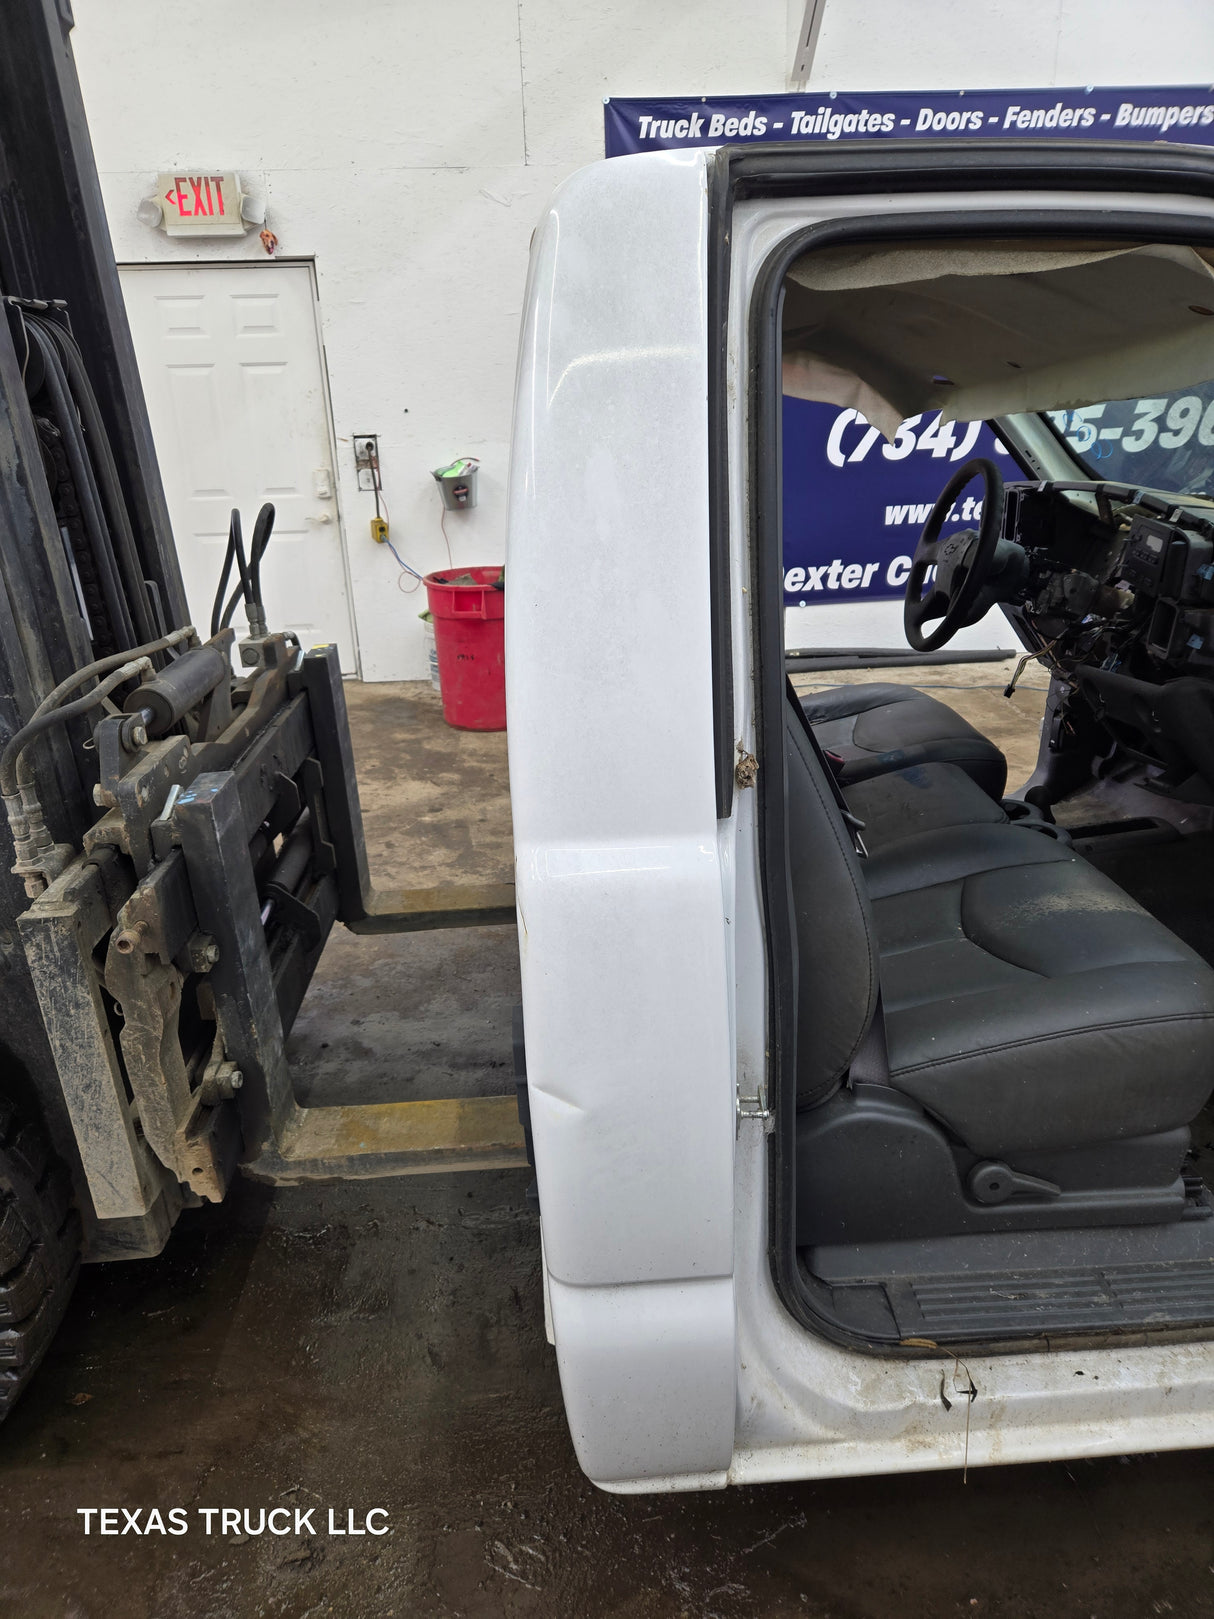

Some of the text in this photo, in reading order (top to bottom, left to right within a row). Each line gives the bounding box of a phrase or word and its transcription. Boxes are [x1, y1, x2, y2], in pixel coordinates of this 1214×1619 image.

[639, 113, 704, 138] Truck
[708, 111, 767, 137] Beds
[791, 107, 895, 140] Tailgates
[916, 108, 984, 131] Doors
[1003, 103, 1096, 129] Fenders
[1113, 103, 1214, 133] Bumpers
[174, 176, 224, 217] EXIT
[783, 559, 880, 592] exter
